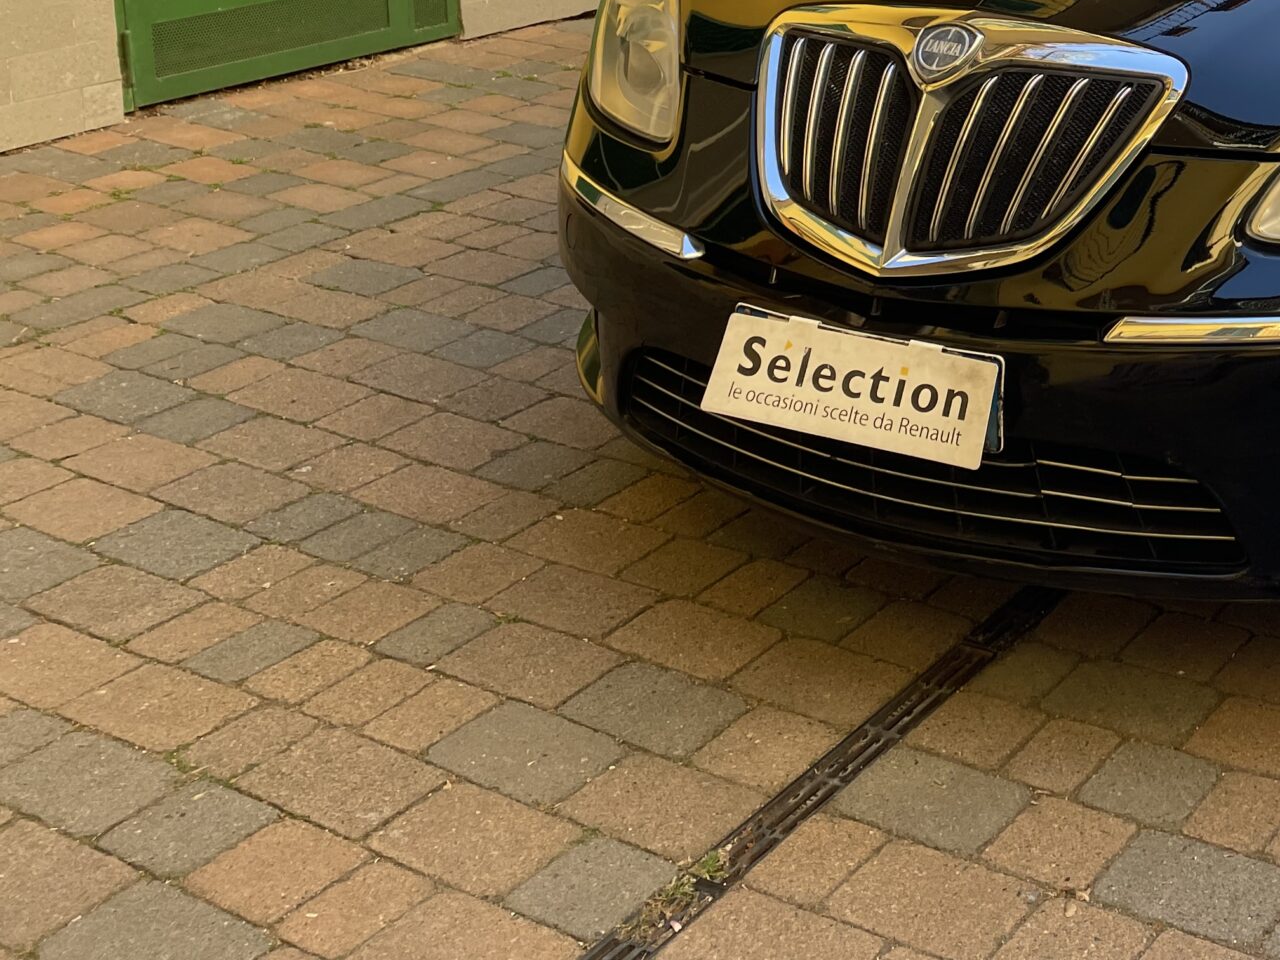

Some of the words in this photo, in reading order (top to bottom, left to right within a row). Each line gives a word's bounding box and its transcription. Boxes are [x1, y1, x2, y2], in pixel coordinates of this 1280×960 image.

[924, 38, 962, 57] LANCIA
[727, 381, 742, 400] le
[745, 389, 820, 416] occasioni
[821, 405, 869, 427] scelte
[873, 412, 894, 433] da
[898, 417, 962, 447] Renault
